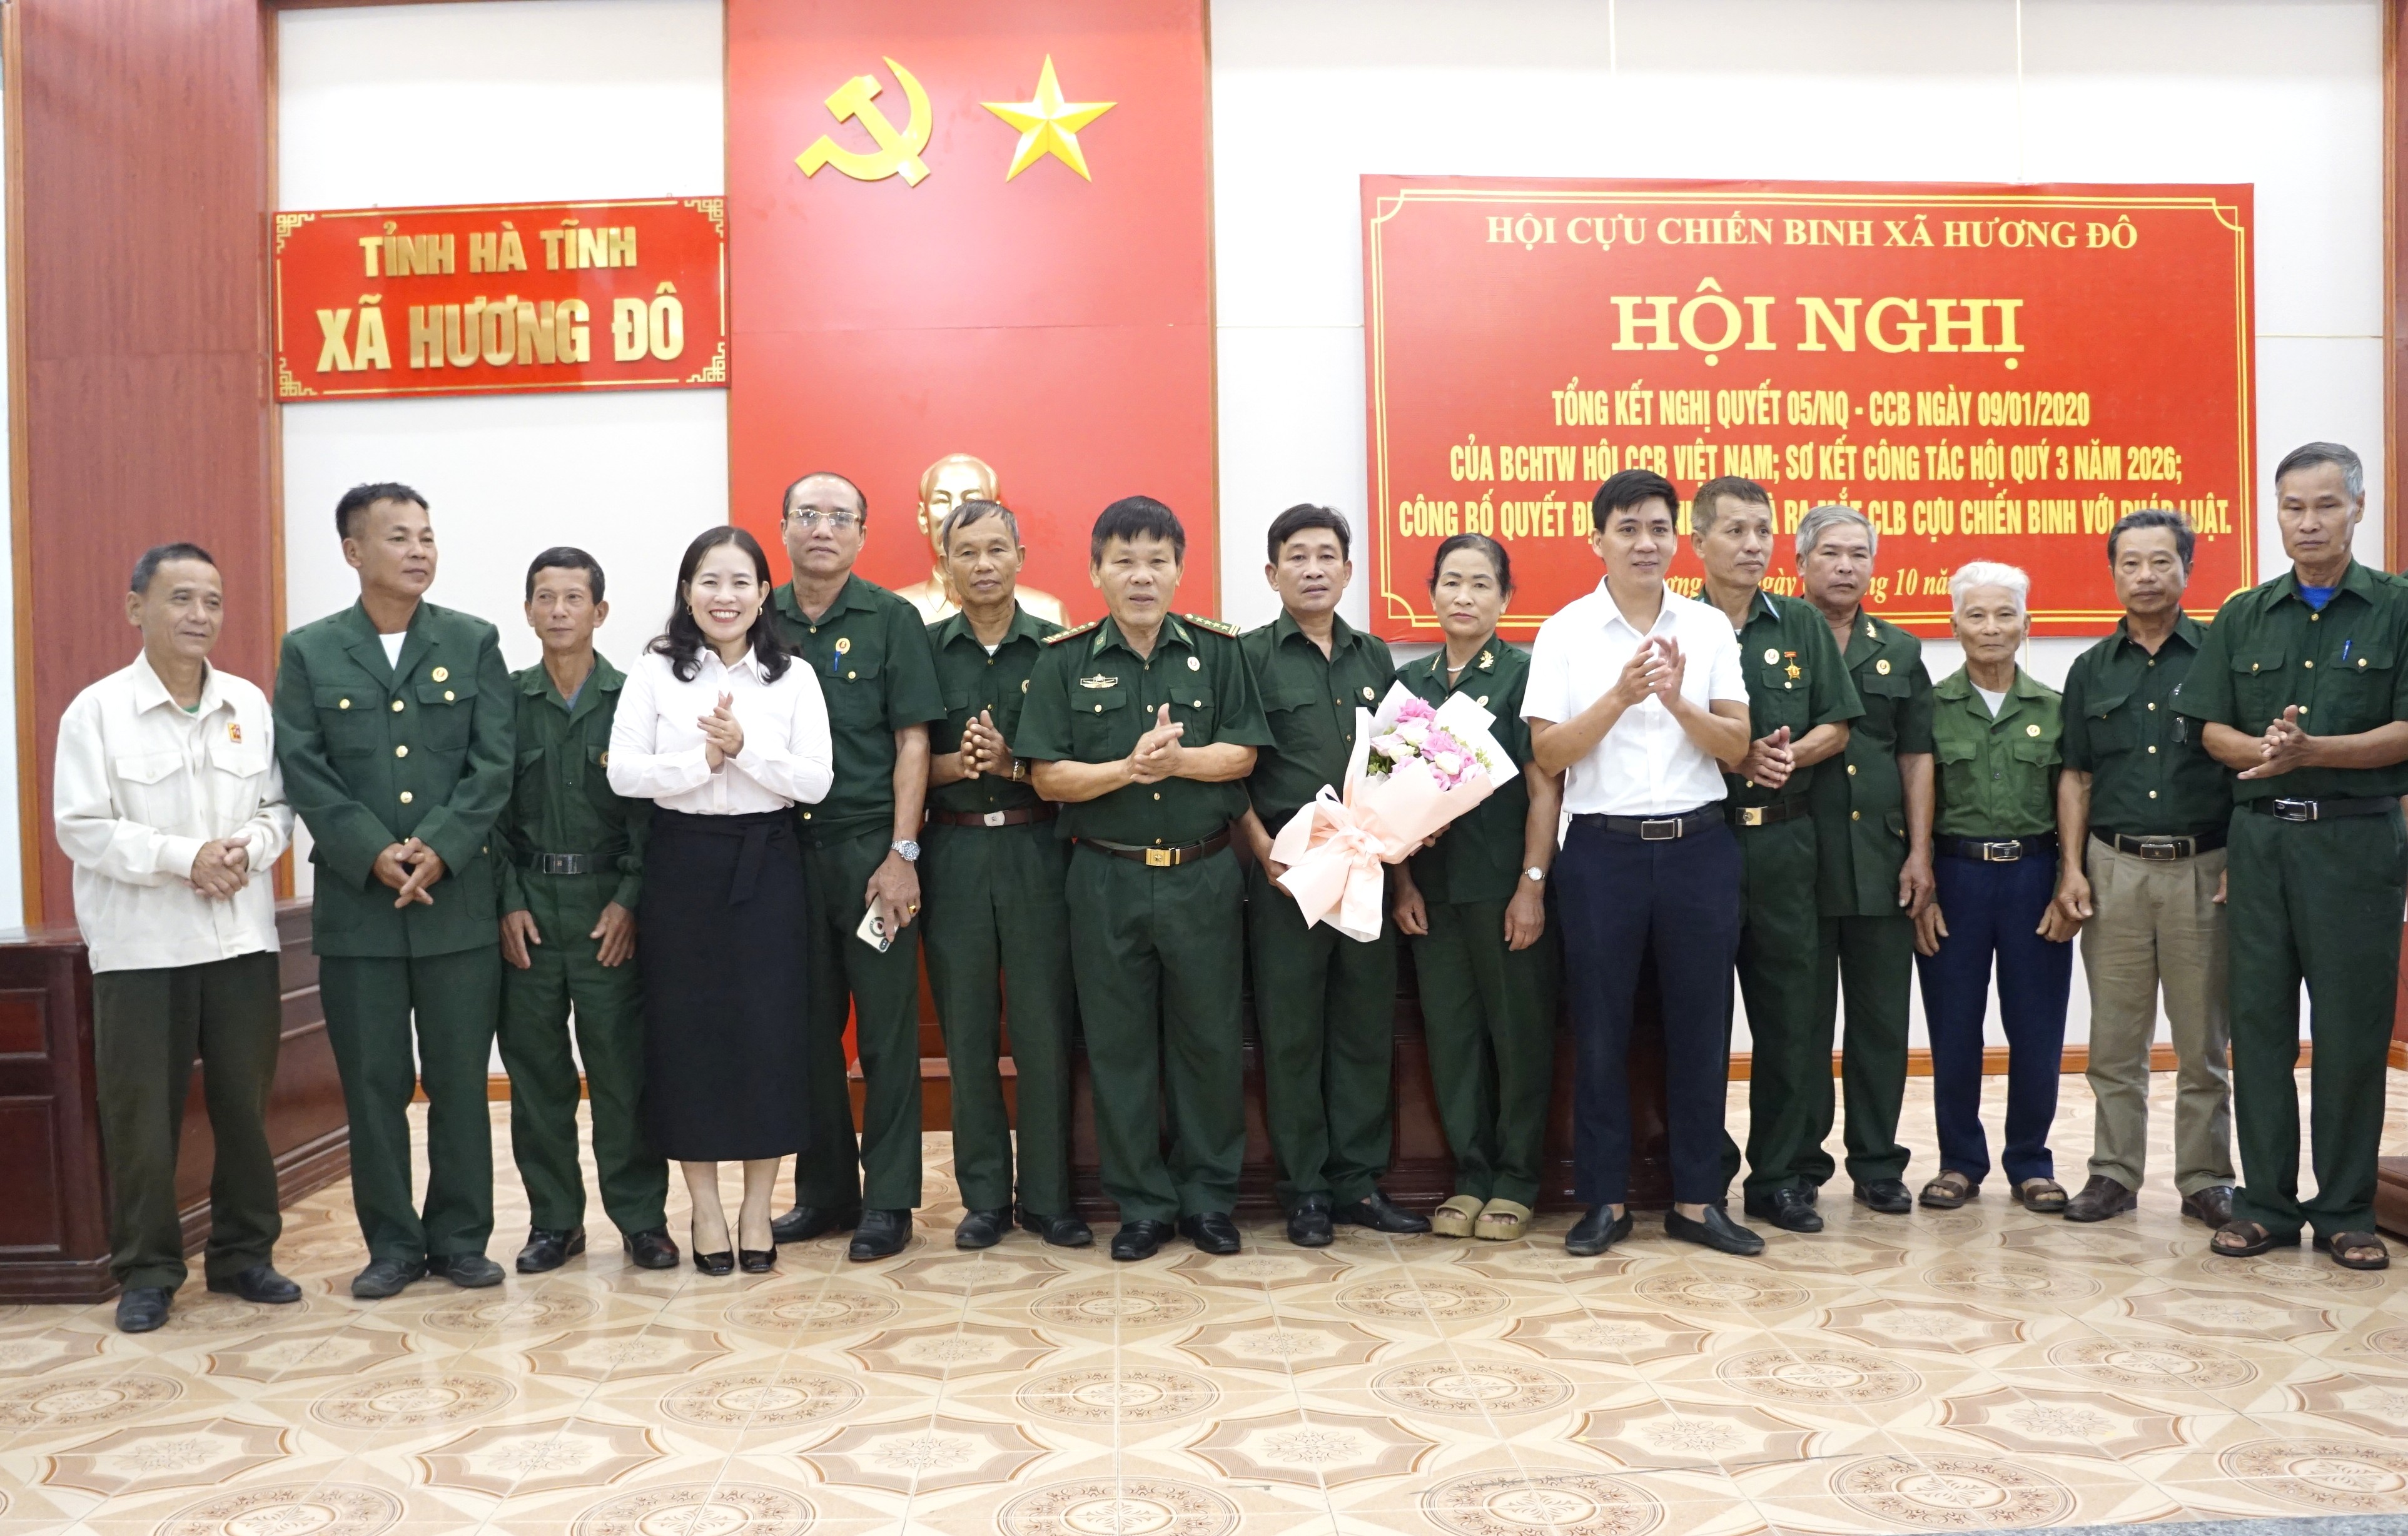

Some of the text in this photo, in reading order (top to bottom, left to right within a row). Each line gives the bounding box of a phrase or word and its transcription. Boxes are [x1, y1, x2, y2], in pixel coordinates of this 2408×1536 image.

[358, 219, 637, 278] TỈNH HÀ TĨNH
[1486, 211, 2138, 251] HỘI CỰU CHIẾN BINH XÃ HƯƠNG ĐÔ
[315, 281, 684, 372] XÃ HƯƠNG ĐÔ
[1610, 276, 2025, 370] HỘI NGHỊ
[1552, 376, 2090, 433] TỔNG KẾT NGHỊ QUYẾT 05/NQ - CCB NGÀY 09/01/2020
[1450, 434, 2183, 488] CỦA BCHTW HỘI CCB VIỆT NAM; SƠ KẾT CÔNG TÁC HỘI QUÝ 3 NĂM 2026;
[1399, 493, 1459, 537] CÔNG
[1465, 488, 1494, 537] BỐ
[1500, 490, 1567, 542] QUYẾT
[1572, 501, 1594, 544] ĐỊ
[1868, 500, 1908, 536] CLB
[1913, 497, 1955, 543] CỰU
[1960, 488, 2023, 535] CHIẾN
[2028, 500, 2077, 535] BINH
[2082, 492, 2115, 535] VỚI
[1666, 575, 1702, 599] ơng
[1758, 567, 1797, 597] gày
[1894, 568, 1919, 596] 10
[1922, 567, 1953, 595] nă
